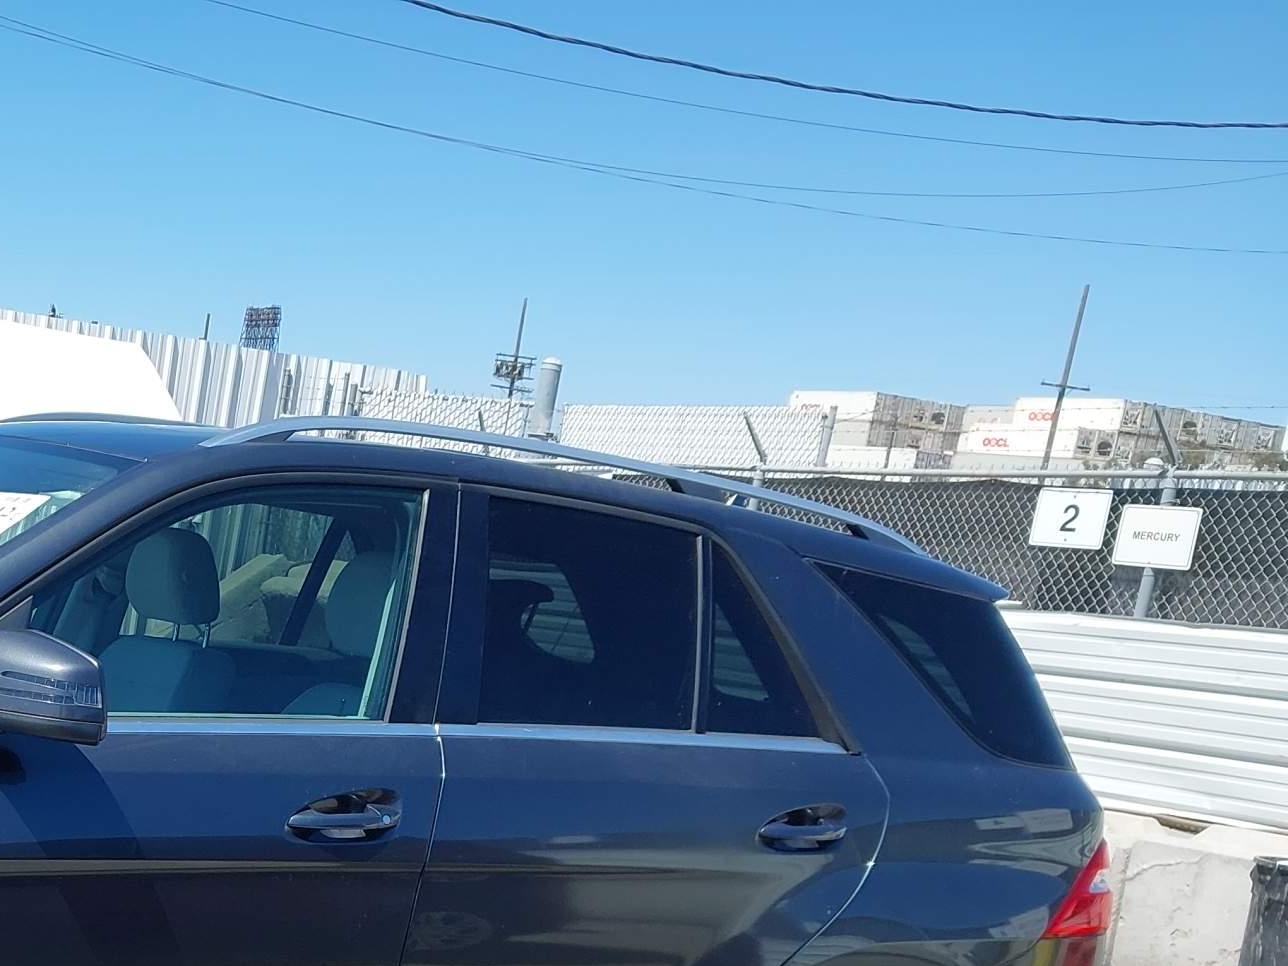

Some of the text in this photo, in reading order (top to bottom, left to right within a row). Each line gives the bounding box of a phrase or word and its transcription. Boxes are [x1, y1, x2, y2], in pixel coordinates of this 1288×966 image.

[982, 437, 1009, 448] OOCL
[1059, 504, 1080, 532] 2
[1132, 530, 1181, 543] MERCURY
